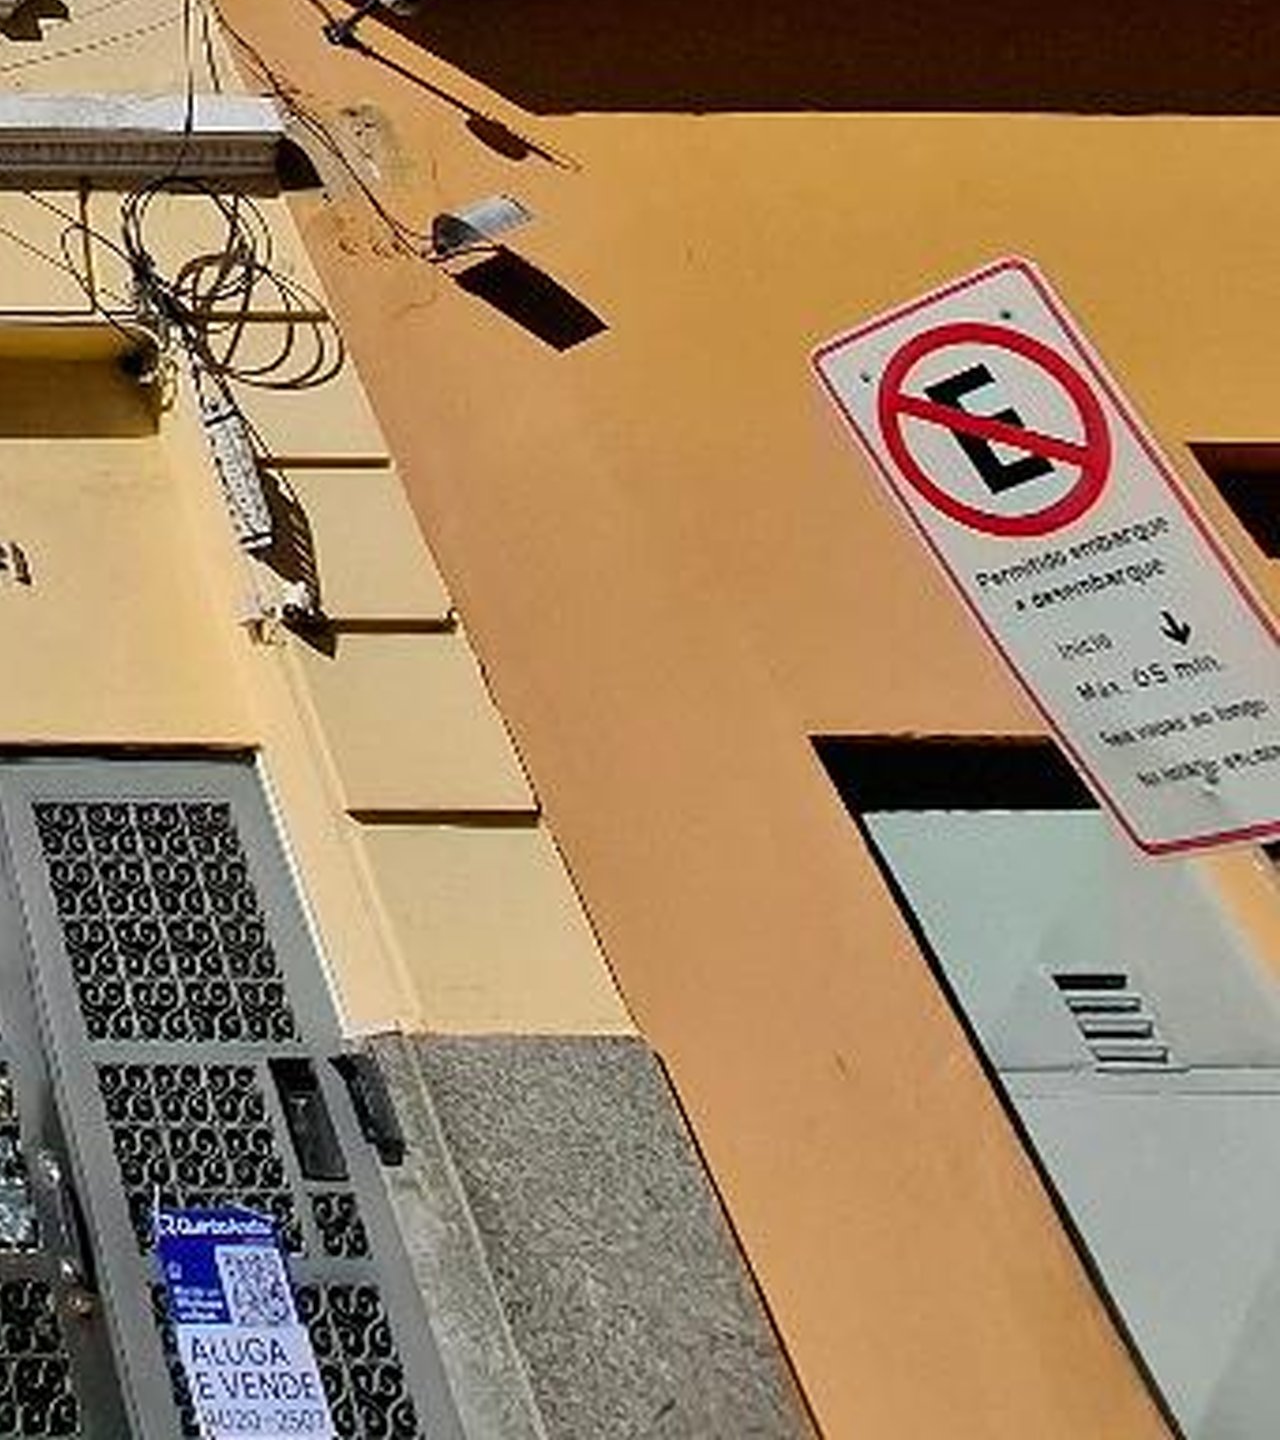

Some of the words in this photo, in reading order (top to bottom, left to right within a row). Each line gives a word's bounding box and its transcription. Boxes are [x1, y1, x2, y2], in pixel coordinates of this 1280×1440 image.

[974, 555, 1068, 590] Permitido
[1069, 516, 1170, 562] embarque
[191, 1337, 290, 1366] ALUGA
[195, 1371, 217, 1400] E
[218, 1371, 318, 1401] VENDE
